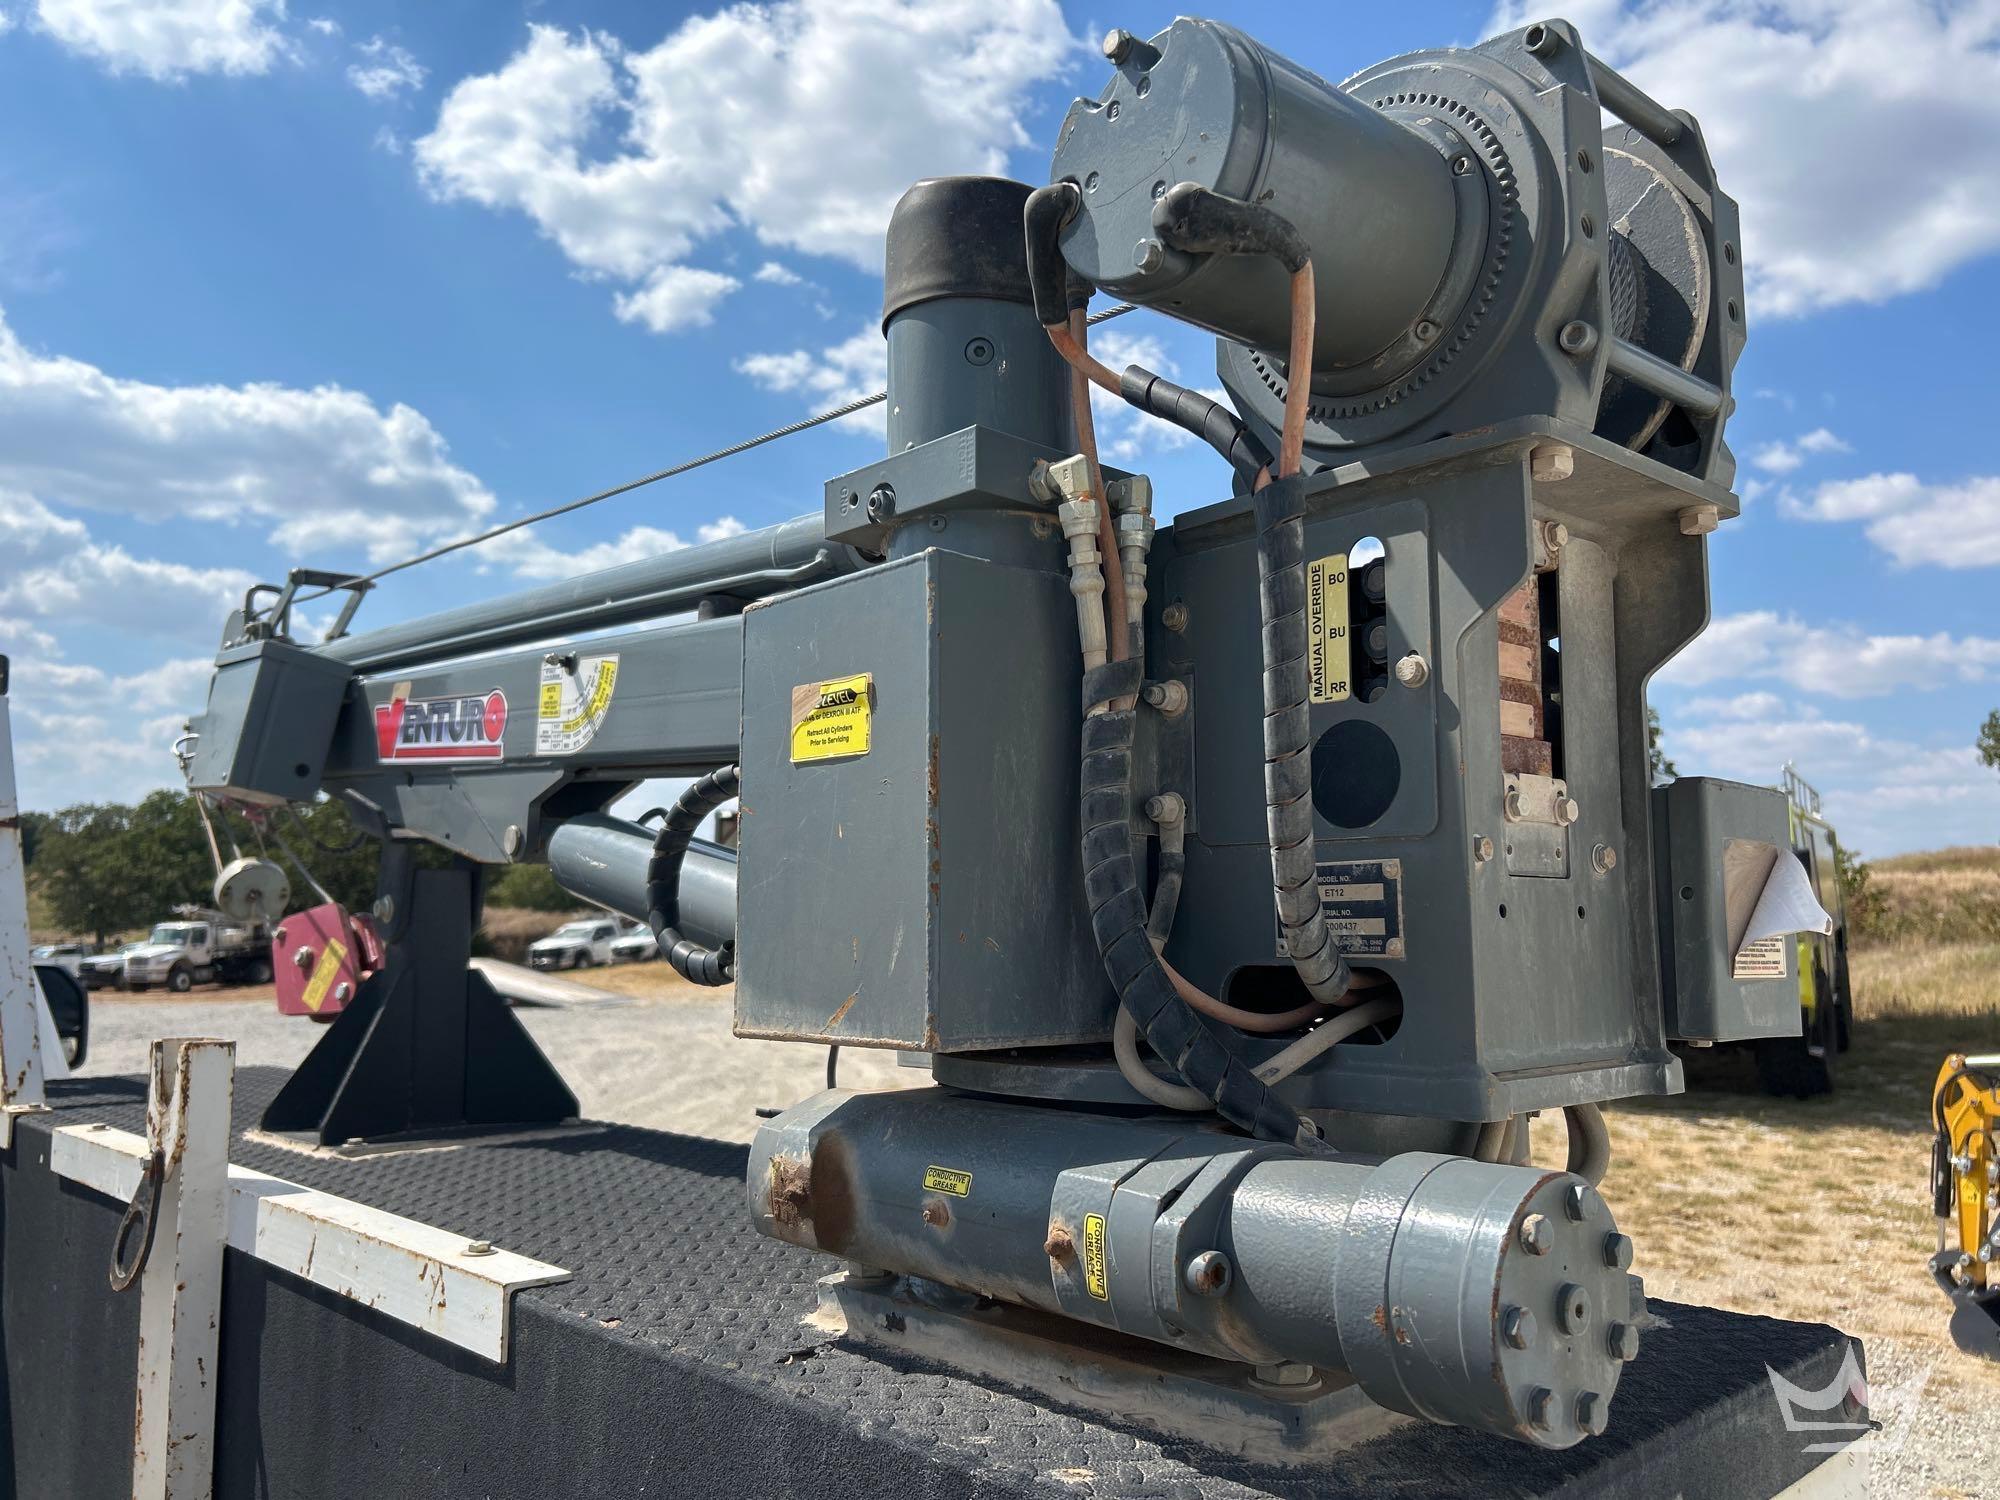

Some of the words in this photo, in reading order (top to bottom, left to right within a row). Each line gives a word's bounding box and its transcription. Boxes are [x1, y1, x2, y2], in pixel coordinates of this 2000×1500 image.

[1328, 572, 1345, 585] BO
[1311, 564, 1322, 634] OVERRIDE
[1329, 626, 1345, 639] BU
[1313, 638, 1323, 697] MANUAL
[1330, 681, 1347, 693] RR
[821, 690, 854, 707] LEVEL
[822, 708, 845, 720] DEXRON
[850, 705, 861, 715] ATF
[375, 692, 507, 760] VENTURO
[807, 728, 823, 737] Retract
[830, 724, 853, 735] Cylinders
[810, 738, 821, 746] Prior
[827, 734, 849, 744] Servicing
[1317, 875, 1339, 883] MODEL
[1324, 888, 1344, 897] ET12
[928, 1169, 967, 1184] CONDUCTIVE
[932, 1179, 958, 1191] GREASE
